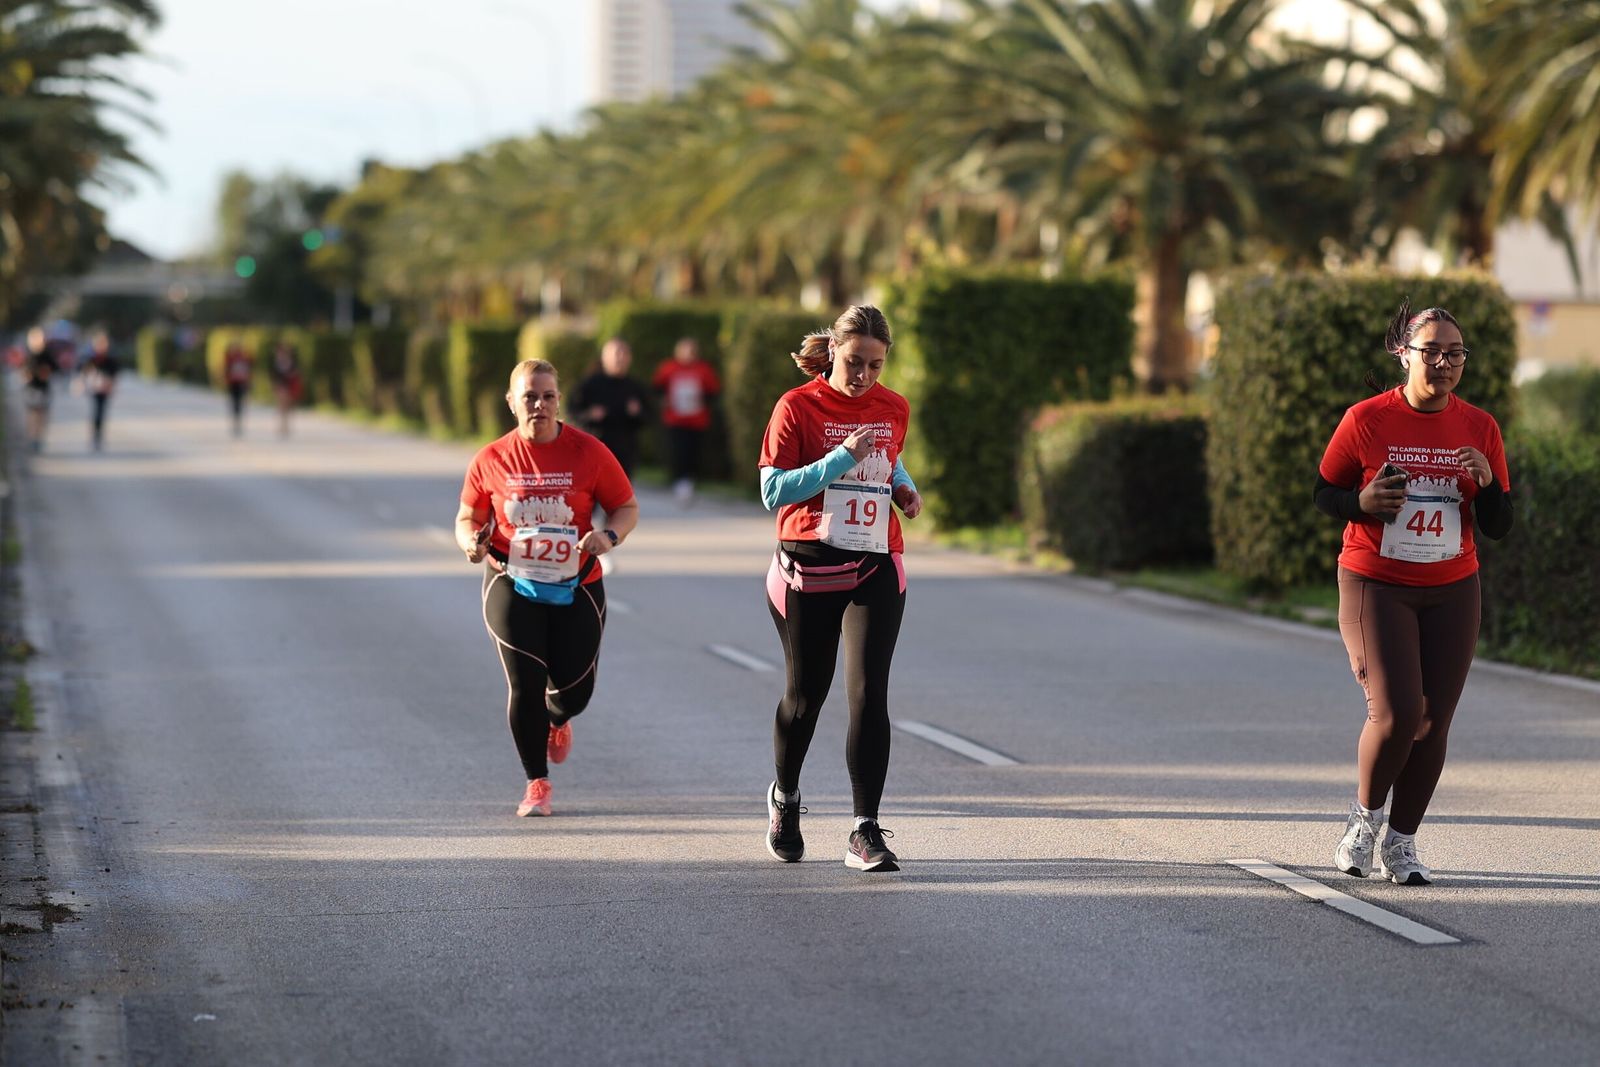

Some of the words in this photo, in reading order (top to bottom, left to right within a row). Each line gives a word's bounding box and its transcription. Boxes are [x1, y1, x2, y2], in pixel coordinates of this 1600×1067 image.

[825, 428, 853, 436] CIUDA
[1388, 453, 1428, 463] CIUDAD
[1431, 455, 1459, 465] JARD
[540, 476, 572, 486] JARDÍN
[844, 498, 878, 527] 19
[1406, 510, 1444, 537] 44
[520, 538, 571, 563] 129
